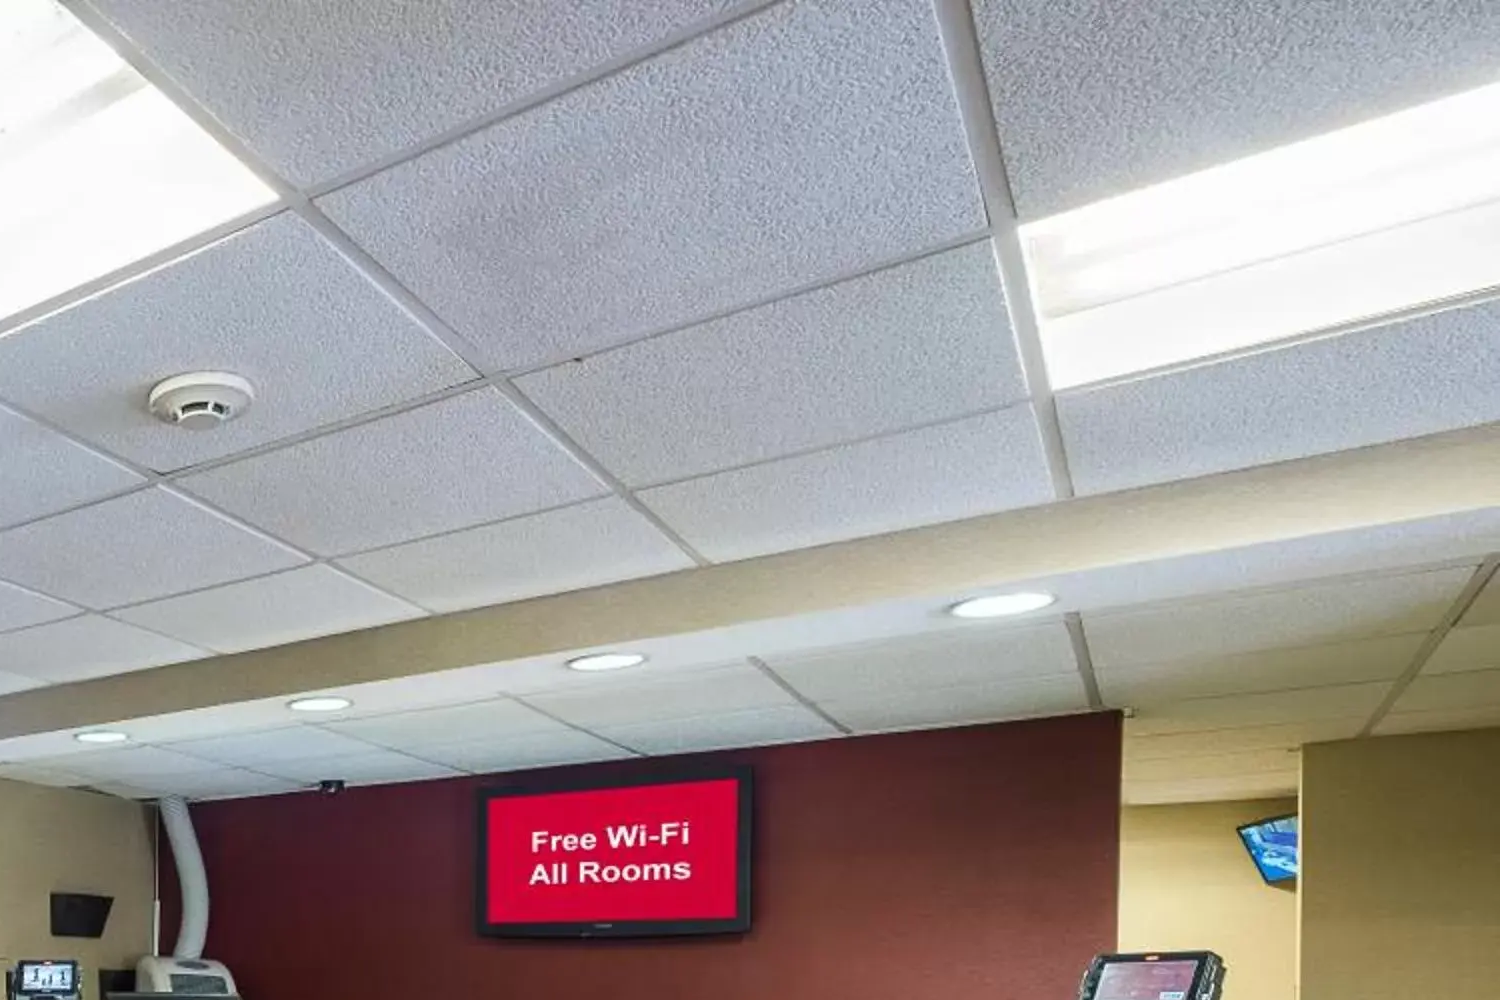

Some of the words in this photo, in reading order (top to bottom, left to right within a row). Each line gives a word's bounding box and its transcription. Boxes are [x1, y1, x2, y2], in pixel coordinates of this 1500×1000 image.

[531, 830, 597, 853] Free
[606, 821, 690, 849] Wi-Fi
[529, 863, 568, 886] All
[579, 861, 692, 884] Rooms
